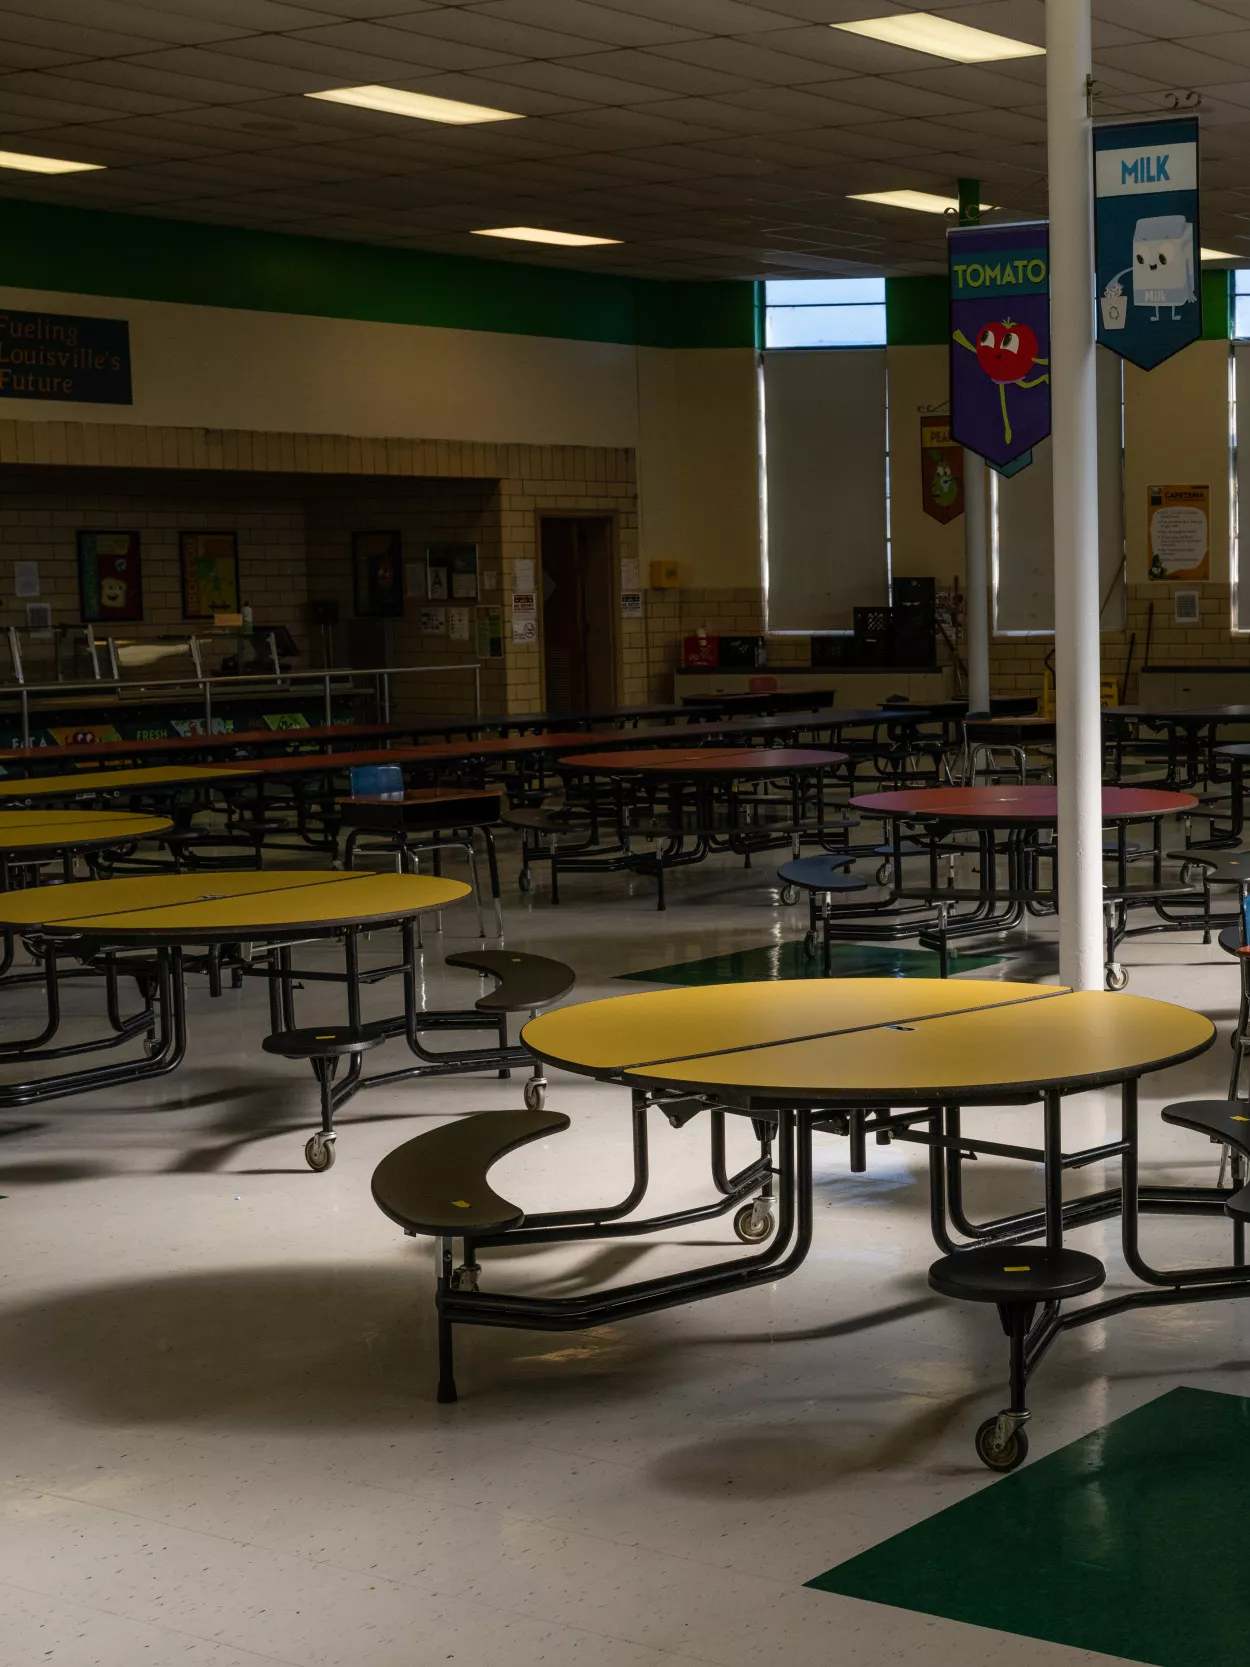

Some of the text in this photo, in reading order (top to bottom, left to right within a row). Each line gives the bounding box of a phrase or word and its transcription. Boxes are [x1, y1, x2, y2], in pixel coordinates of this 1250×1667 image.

[1121, 155, 1170, 185] MILK
[953, 258, 1046, 289] TOMATO
[1144, 290, 1167, 303] Milk
[0, 342, 121, 371] Louisville's
[0, 367, 74, 394] Future
[930, 430, 954, 443] PEA
[136, 728, 168, 741] FRESH
